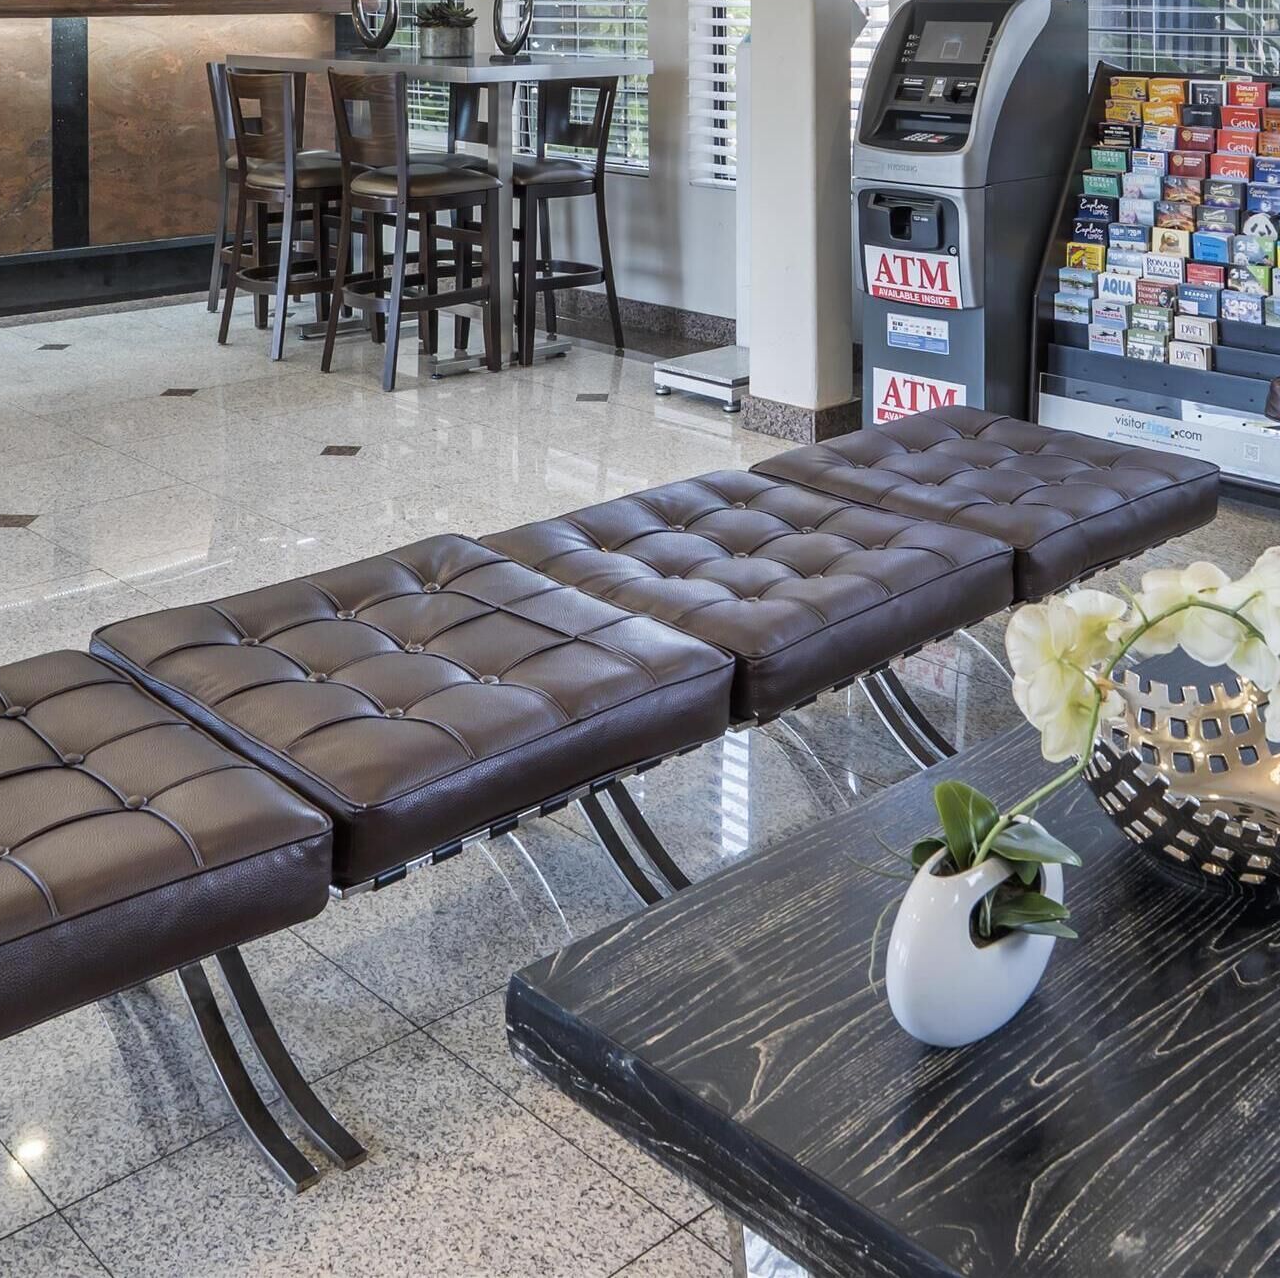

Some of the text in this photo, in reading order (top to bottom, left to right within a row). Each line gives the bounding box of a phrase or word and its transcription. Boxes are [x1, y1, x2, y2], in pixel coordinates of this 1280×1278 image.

[1231, 118, 1257, 129] Getty
[1227, 142, 1253, 153] Getty
[1220, 166, 1247, 178] Getty
[1147, 257, 1180, 269] RONALD
[874, 253, 952, 292] ATM
[1147, 265, 1180, 275] REAGAN
[1102, 277, 1133, 297] AQUA
[879, 288, 951, 305] AVAILABLE INSIDE
[1184, 290, 1213, 299] SEAPORT
[882, 376, 958, 412] ATM
